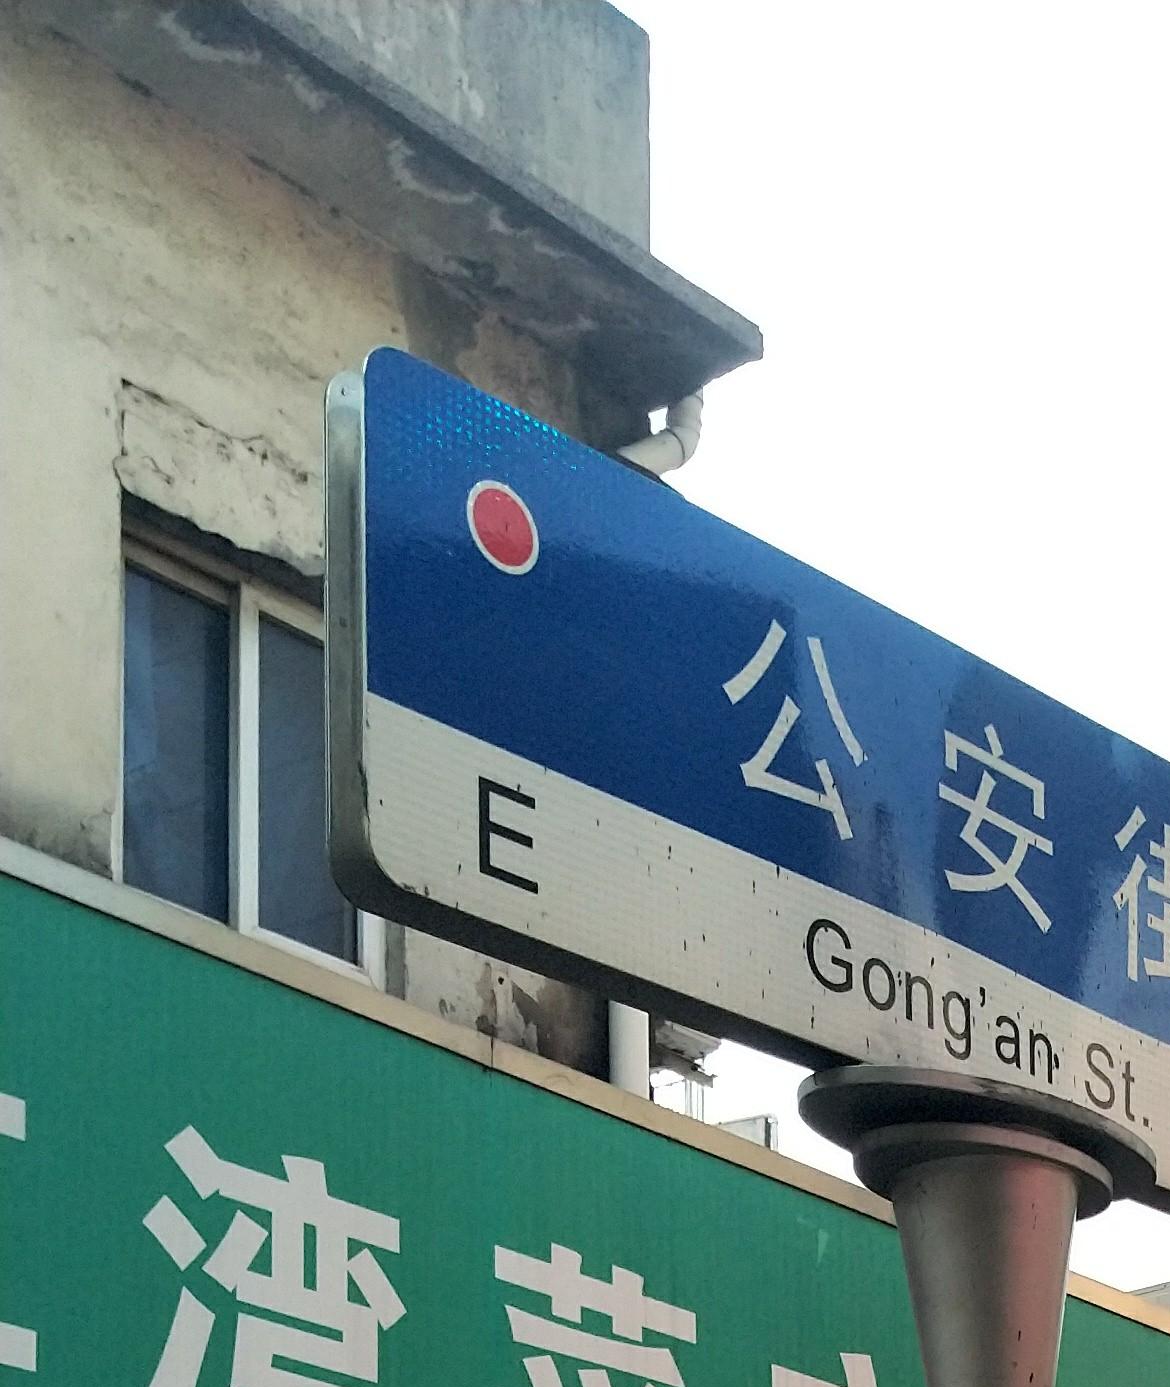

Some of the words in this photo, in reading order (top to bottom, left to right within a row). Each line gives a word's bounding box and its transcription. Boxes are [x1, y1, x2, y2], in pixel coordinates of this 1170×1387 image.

[477, 775, 538, 895] E
[804, 917, 1054, 1086] Gong'an
[1084, 1042, 1152, 1129] St.
